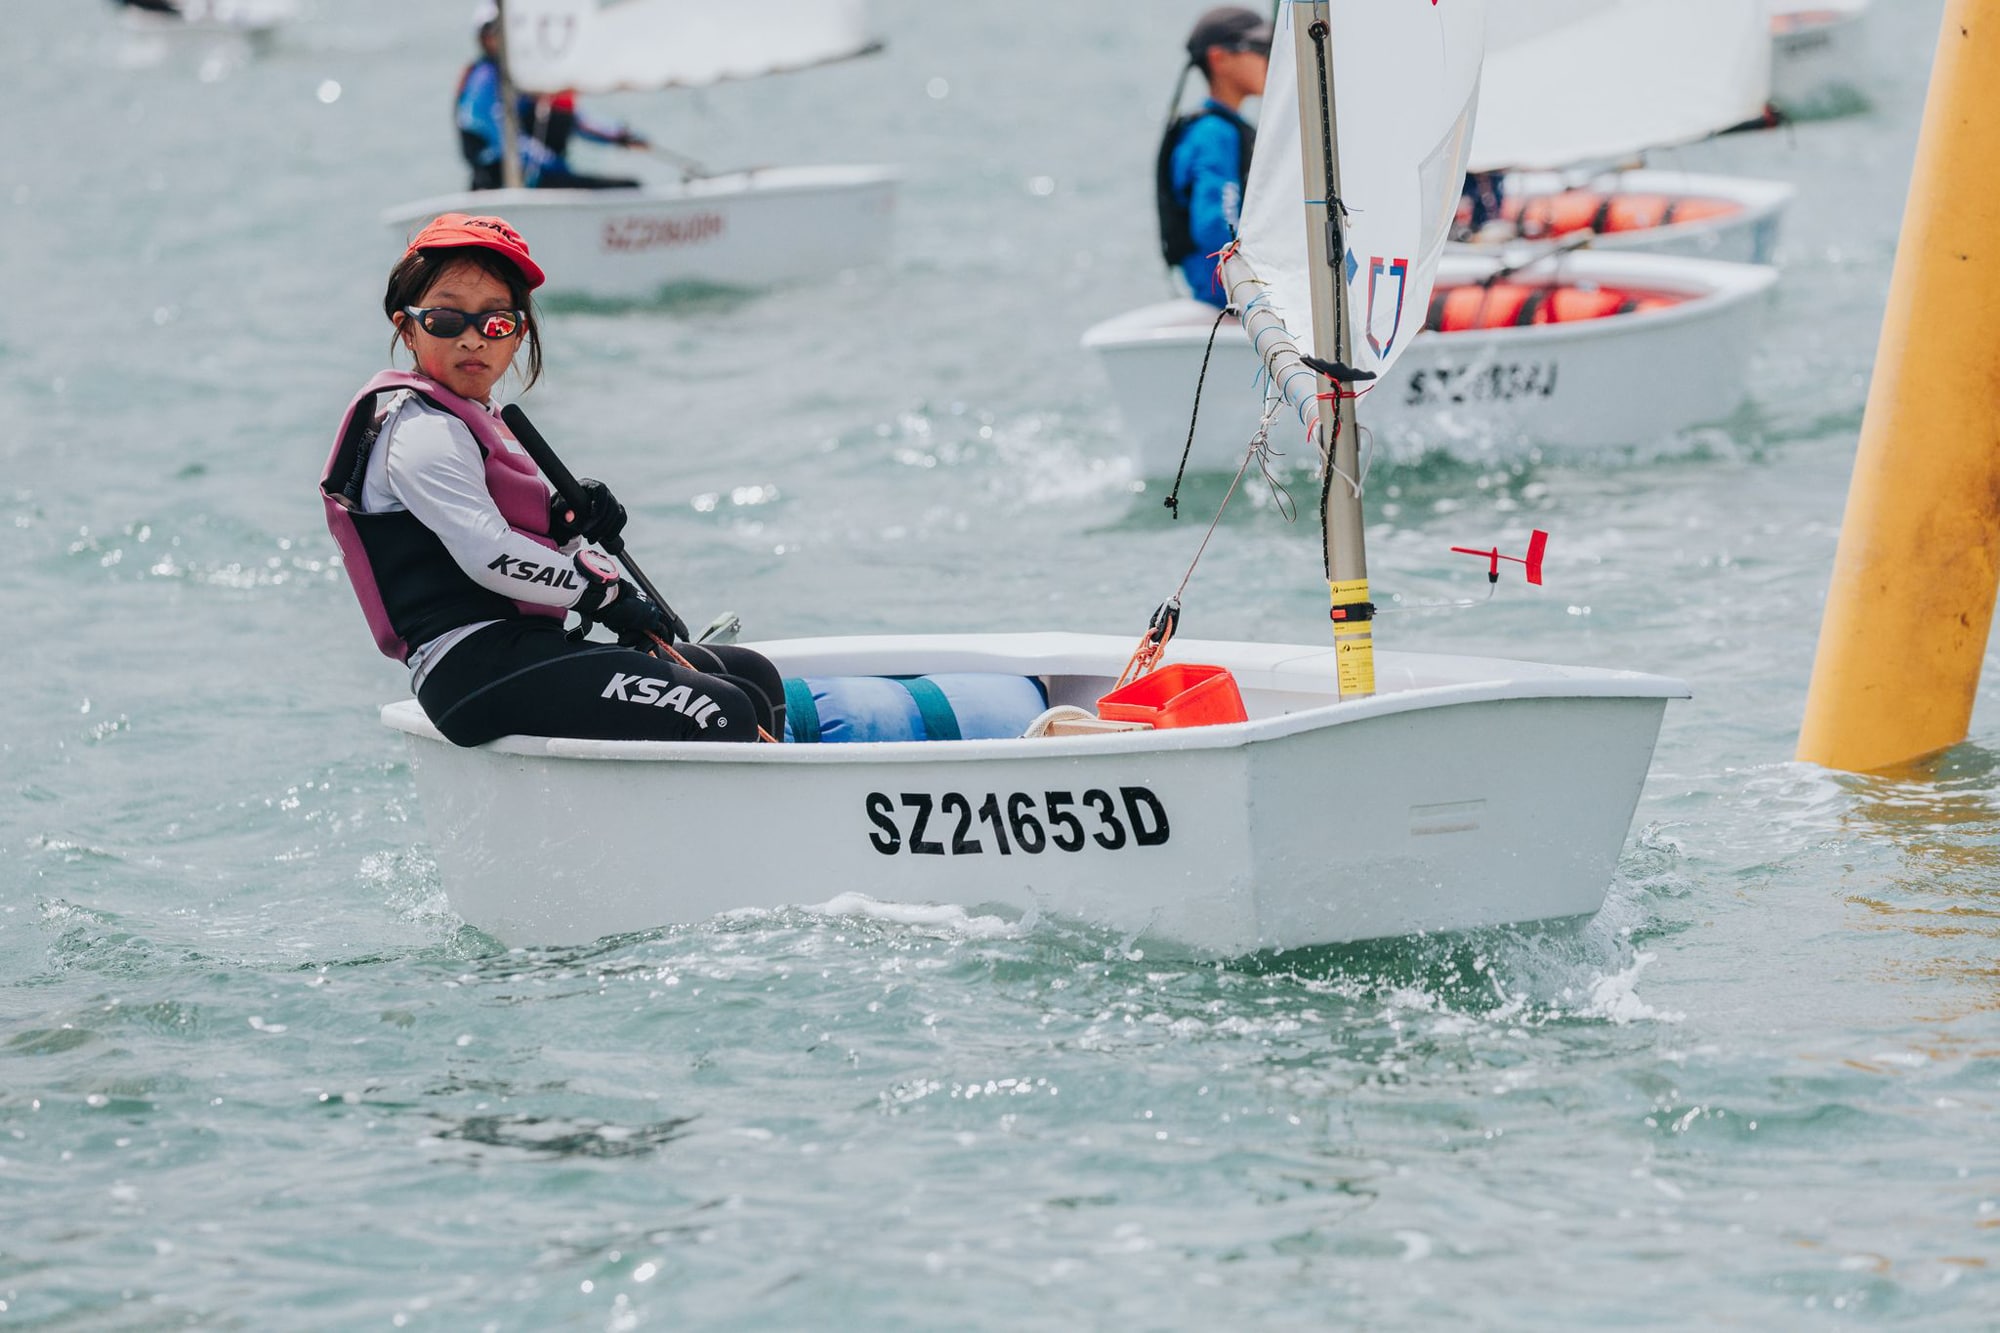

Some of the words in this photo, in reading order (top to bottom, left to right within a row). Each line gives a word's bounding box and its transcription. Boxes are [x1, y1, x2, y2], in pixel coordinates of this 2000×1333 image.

[487, 553, 579, 590] KSAIL
[601, 672, 721, 729] KSAIL
[865, 786, 1170, 855] SZ21653D
